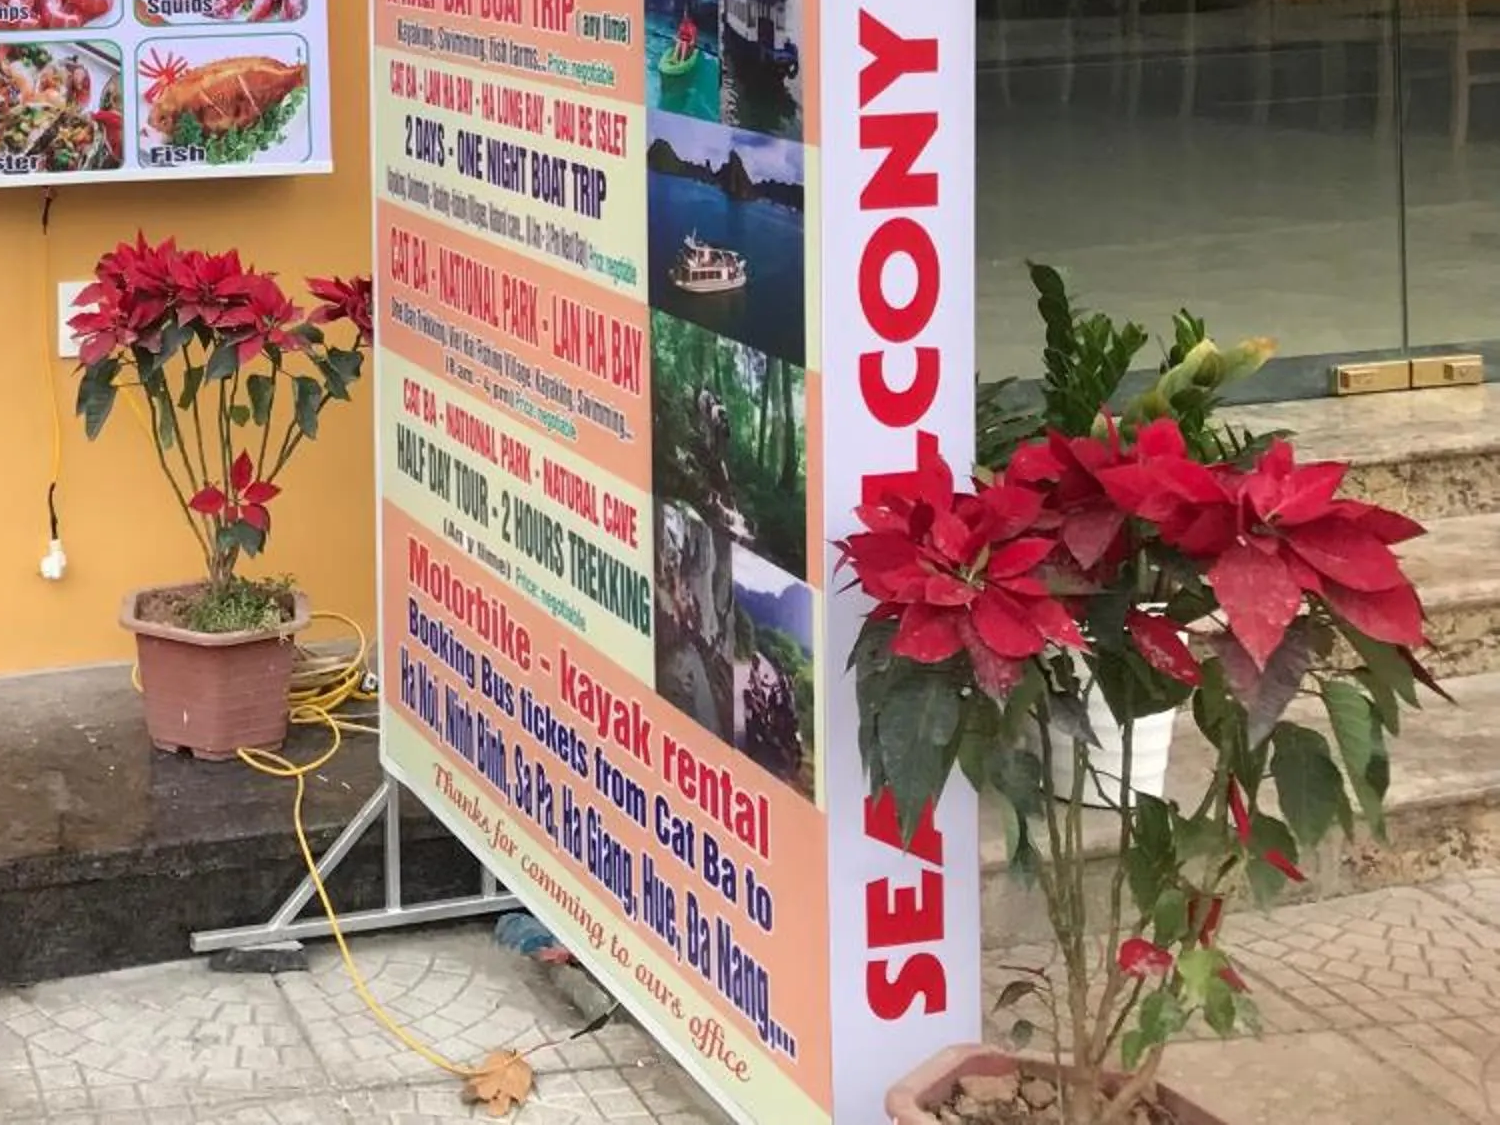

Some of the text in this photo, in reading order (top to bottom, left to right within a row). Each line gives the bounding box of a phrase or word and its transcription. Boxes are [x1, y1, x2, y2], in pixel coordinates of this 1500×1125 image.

[151, 146, 205, 162] Fish
[405, 114, 413, 156] 2
[415, 118, 445, 167] DAYS
[457, 130, 482, 179] ONE
[487, 138, 527, 195] NIGHT
[532, 151, 566, 208] BOAT
[572, 162, 606, 219] TRIP
[857, 5, 941, 515] LCONY
[439, 247, 498, 327] NATIONAL
[503, 273, 538, 347] PARK
[553, 295, 580, 367] LAN
[587, 308, 606, 379] HA
[611, 319, 642, 395] BAY
[397, 422, 650, 638] HALF DAY TOUR 2 HOURS TREKKING
[446, 403, 497, 465] NATIONAL
[500, 434, 531, 484] PARK
[543, 458, 599, 526] NATURAL
[603, 493, 638, 550] CAVE
[400, 645, 417, 707] Ha
[445, 682, 475, 772] Ninh
[477, 708, 510, 802] Binh,
[514, 746, 533, 814] Sa
[536, 764, 559, 845] Pa,
[563, 785, 583, 862] Ha
[587, 807, 637, 923] Giang,
[642, 853, 682, 965] Hue,
[409, 539, 772, 860] Motorbike kayak rental
[409, 598, 774, 933] Booking Bus tickets from Cat Ba to
[433, 763, 492, 841] Thanks
[490, 818, 519, 860] for
[611, 934, 631, 970] to
[635, 961, 684, 1026] ours
[689, 1008, 752, 1083] office
